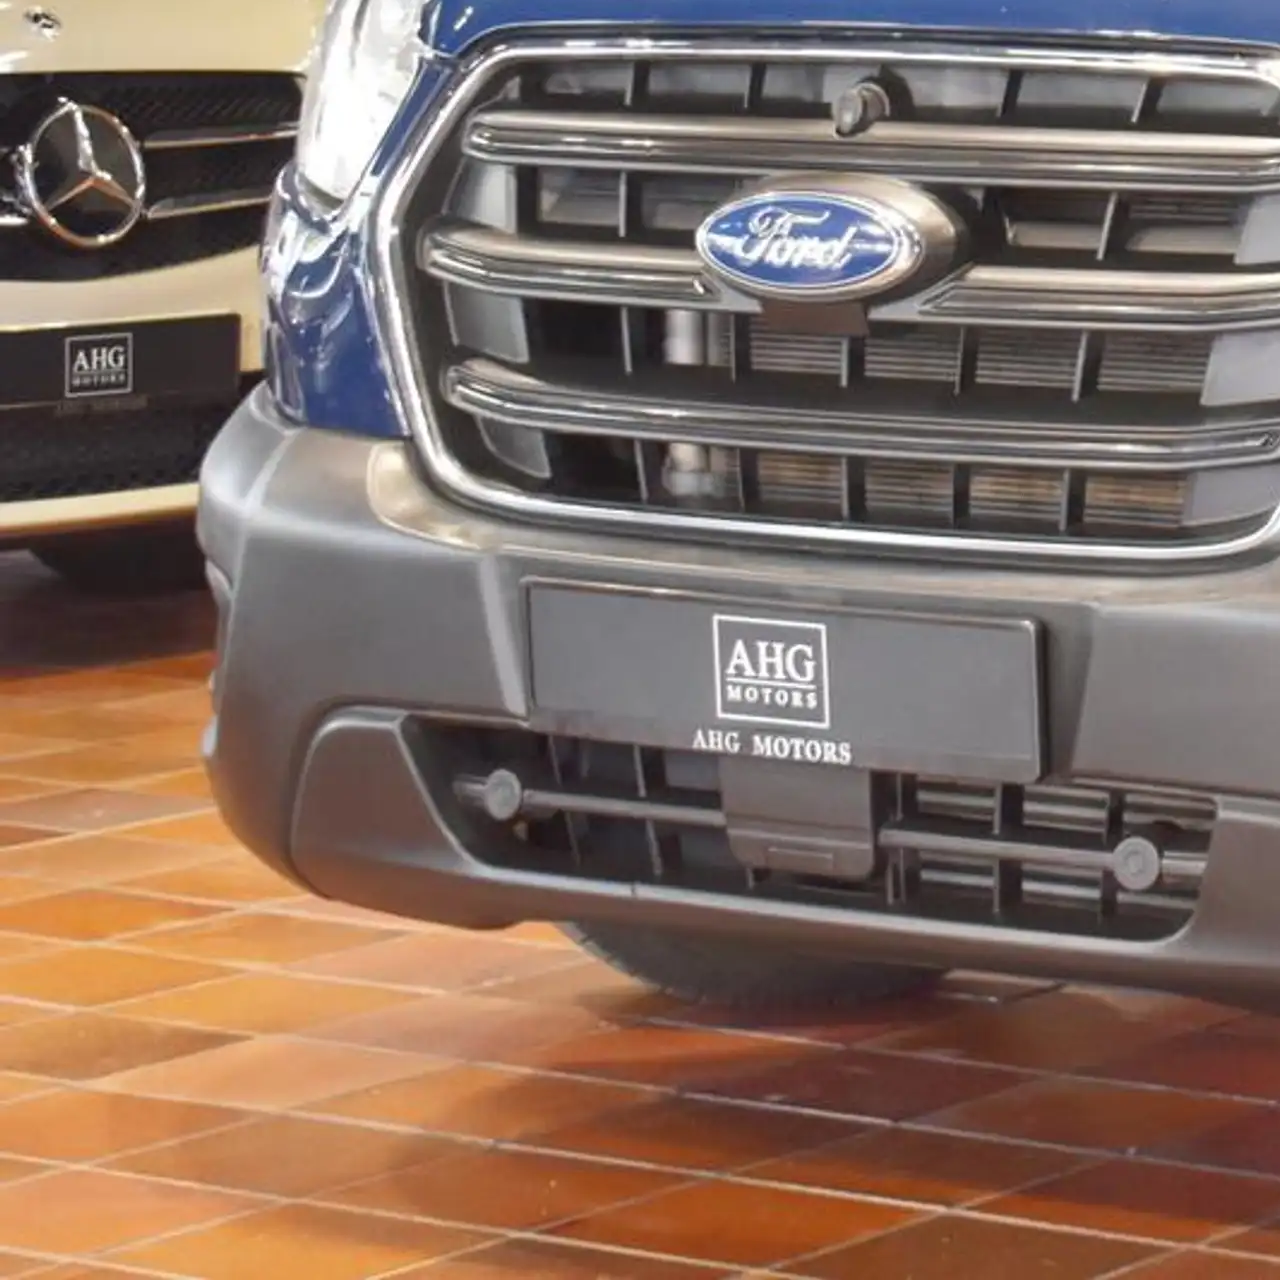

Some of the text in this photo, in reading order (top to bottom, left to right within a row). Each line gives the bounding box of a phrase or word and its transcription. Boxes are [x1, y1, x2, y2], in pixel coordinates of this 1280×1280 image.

[735, 206, 859, 270] Ford
[72, 345, 126, 373] AHG
[725, 639, 817, 683] AHG
[725, 684, 818, 710] MOTORS
[691, 728, 852, 766] AHG MOTORS
